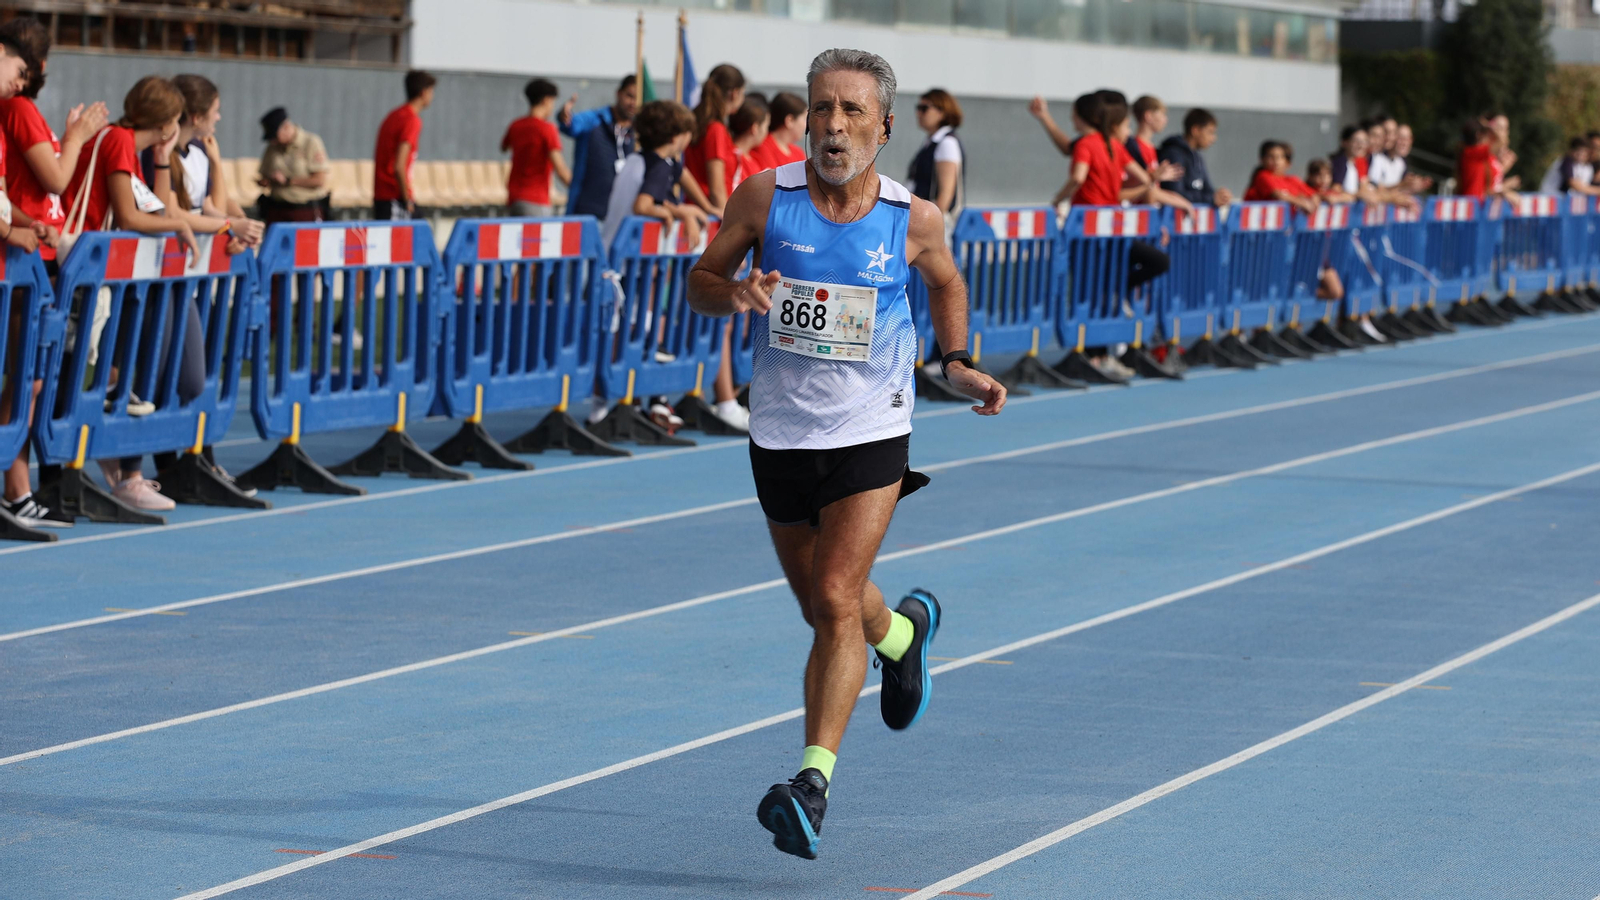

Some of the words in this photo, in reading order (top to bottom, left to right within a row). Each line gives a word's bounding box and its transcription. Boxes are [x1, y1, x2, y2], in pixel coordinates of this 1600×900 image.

[792, 243, 815, 253] rasán
[857, 271, 894, 282] MALAGÓN
[791, 289, 814, 297] POPULAR
[792, 284, 815, 292] CARRERA
[780, 299, 827, 331] 868
